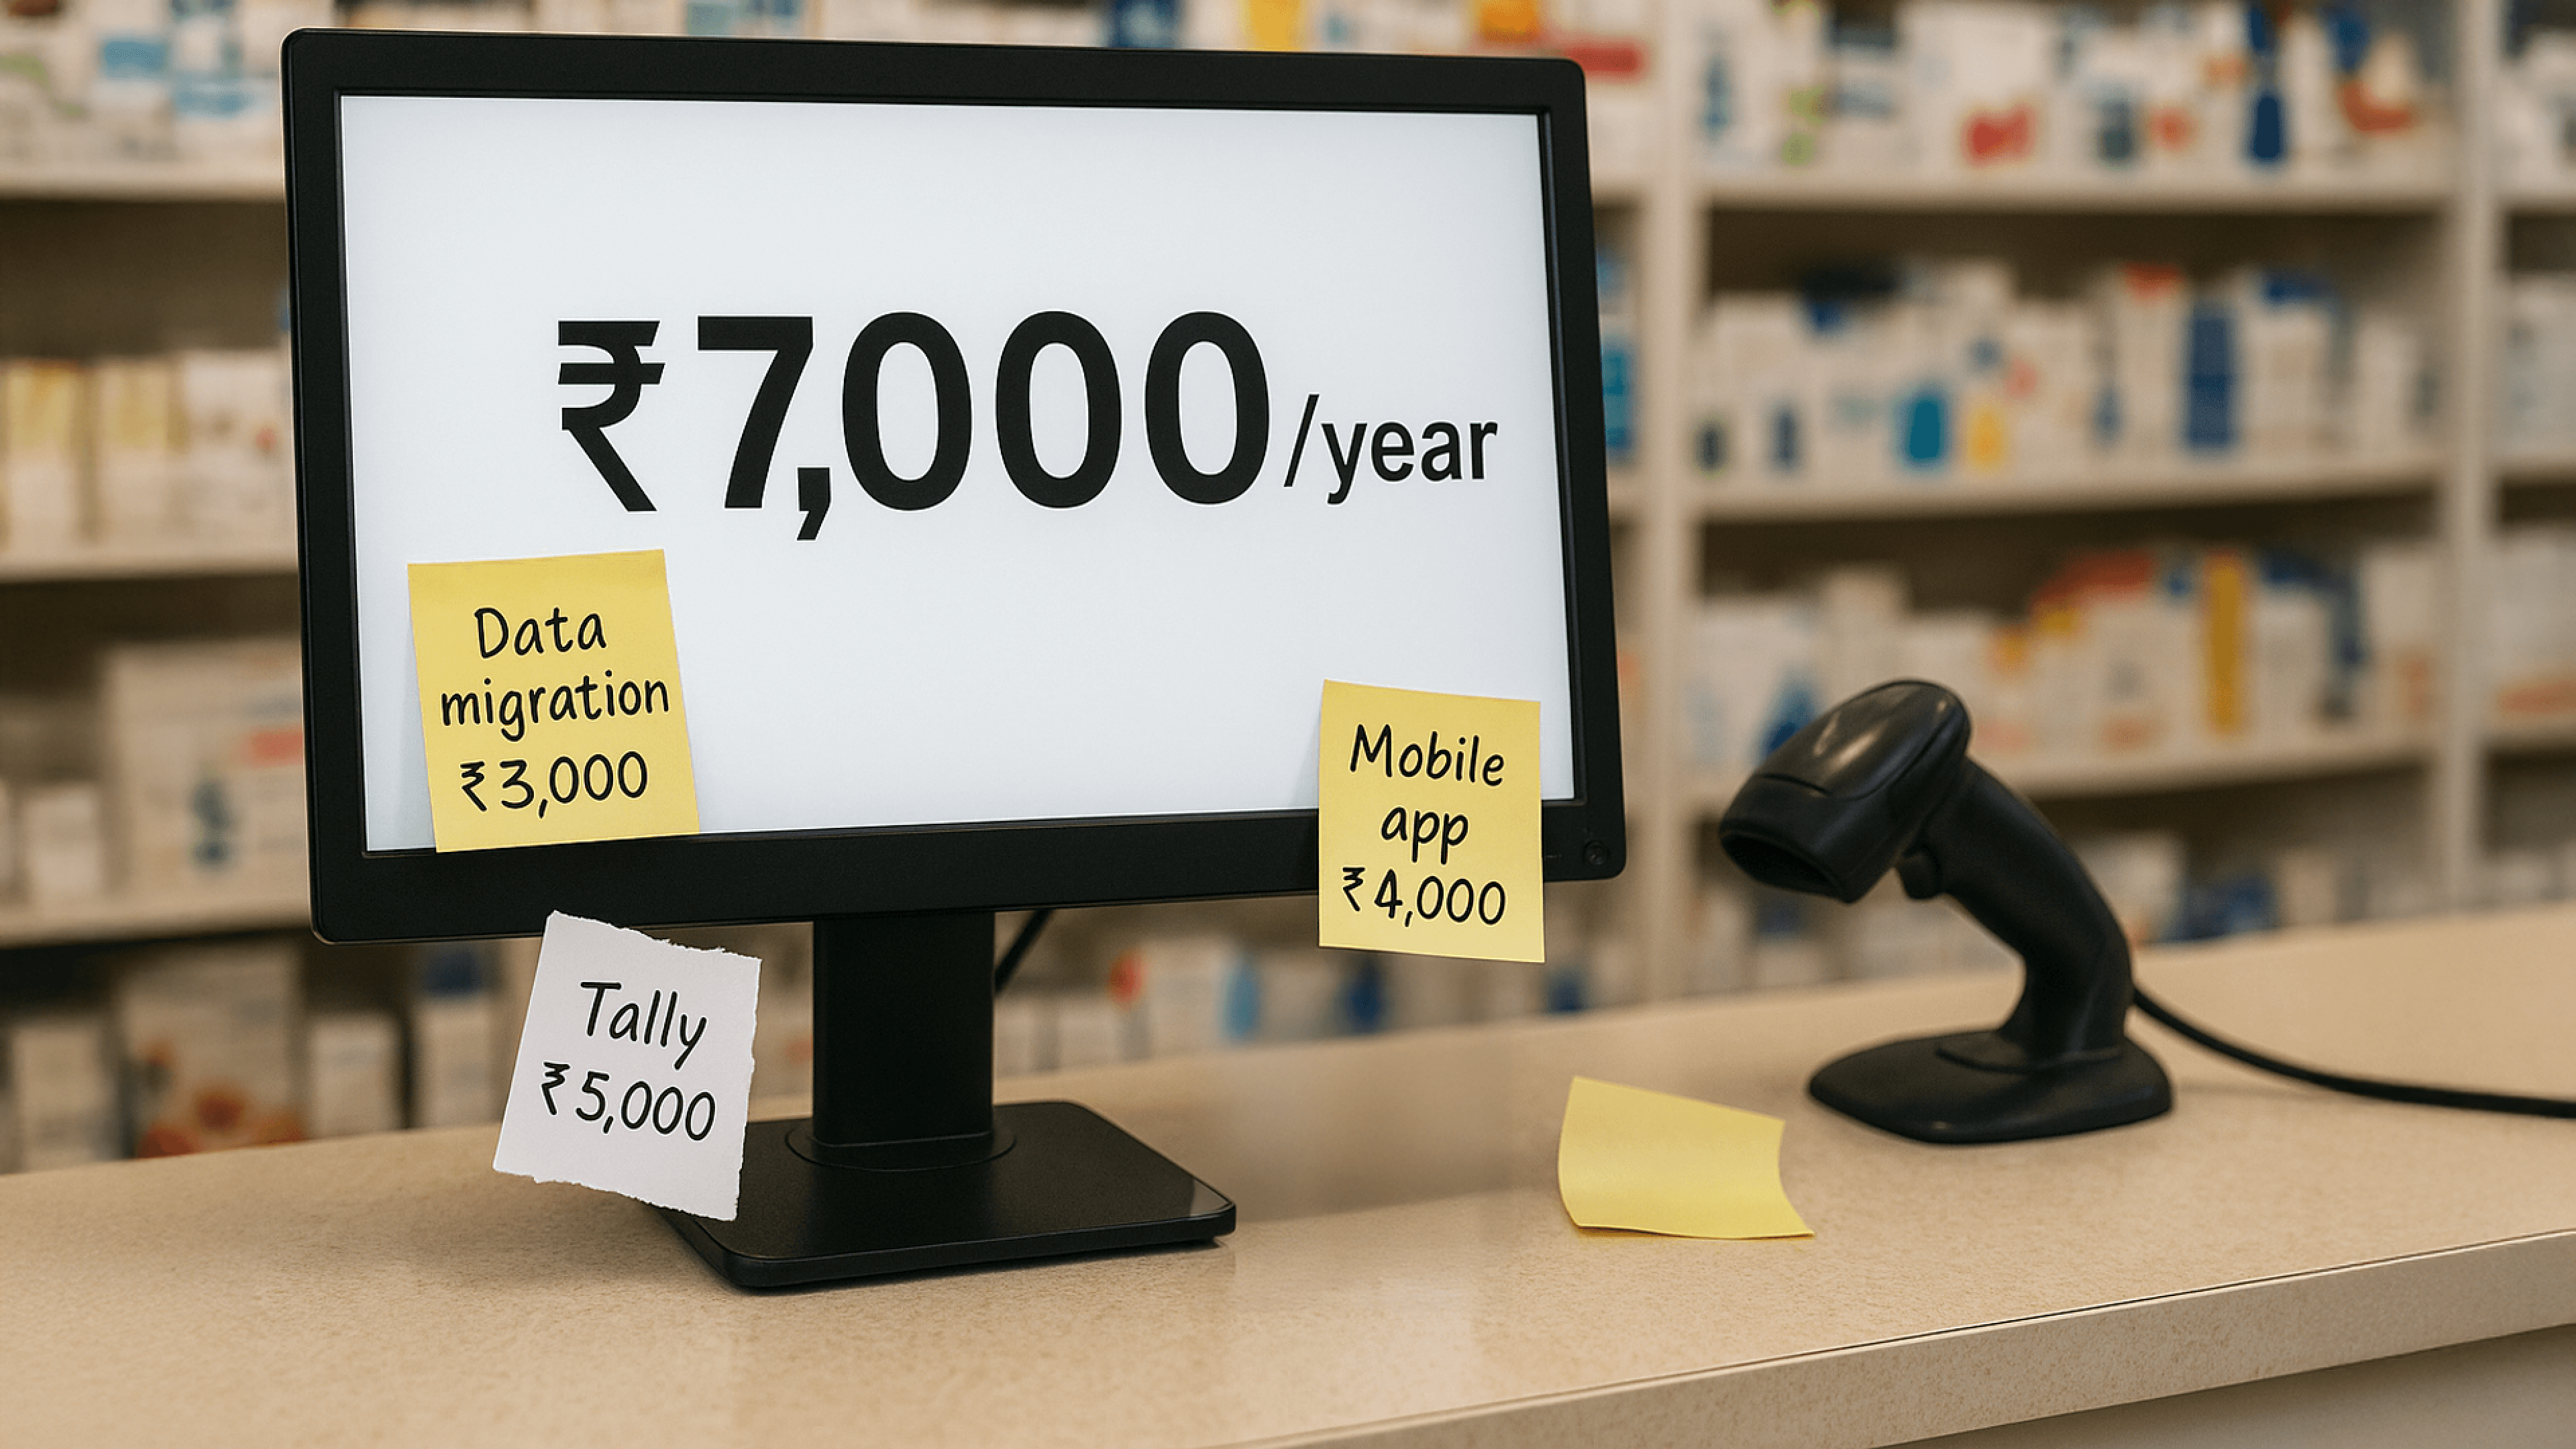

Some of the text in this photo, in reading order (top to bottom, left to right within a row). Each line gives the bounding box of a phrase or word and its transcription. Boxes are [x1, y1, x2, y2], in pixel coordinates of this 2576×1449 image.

[474, 606, 608, 659] Data
[440, 669, 669, 742] migration
[459, 750, 648, 819] ₹3,000
[1348, 723, 1505, 787] Mobile
[1381, 806, 1469, 865] app
[1342, 867, 1507, 928] ₹4,000
[580, 981, 707, 1071] Tally
[541, 1062, 716, 1142] ₹5,000
